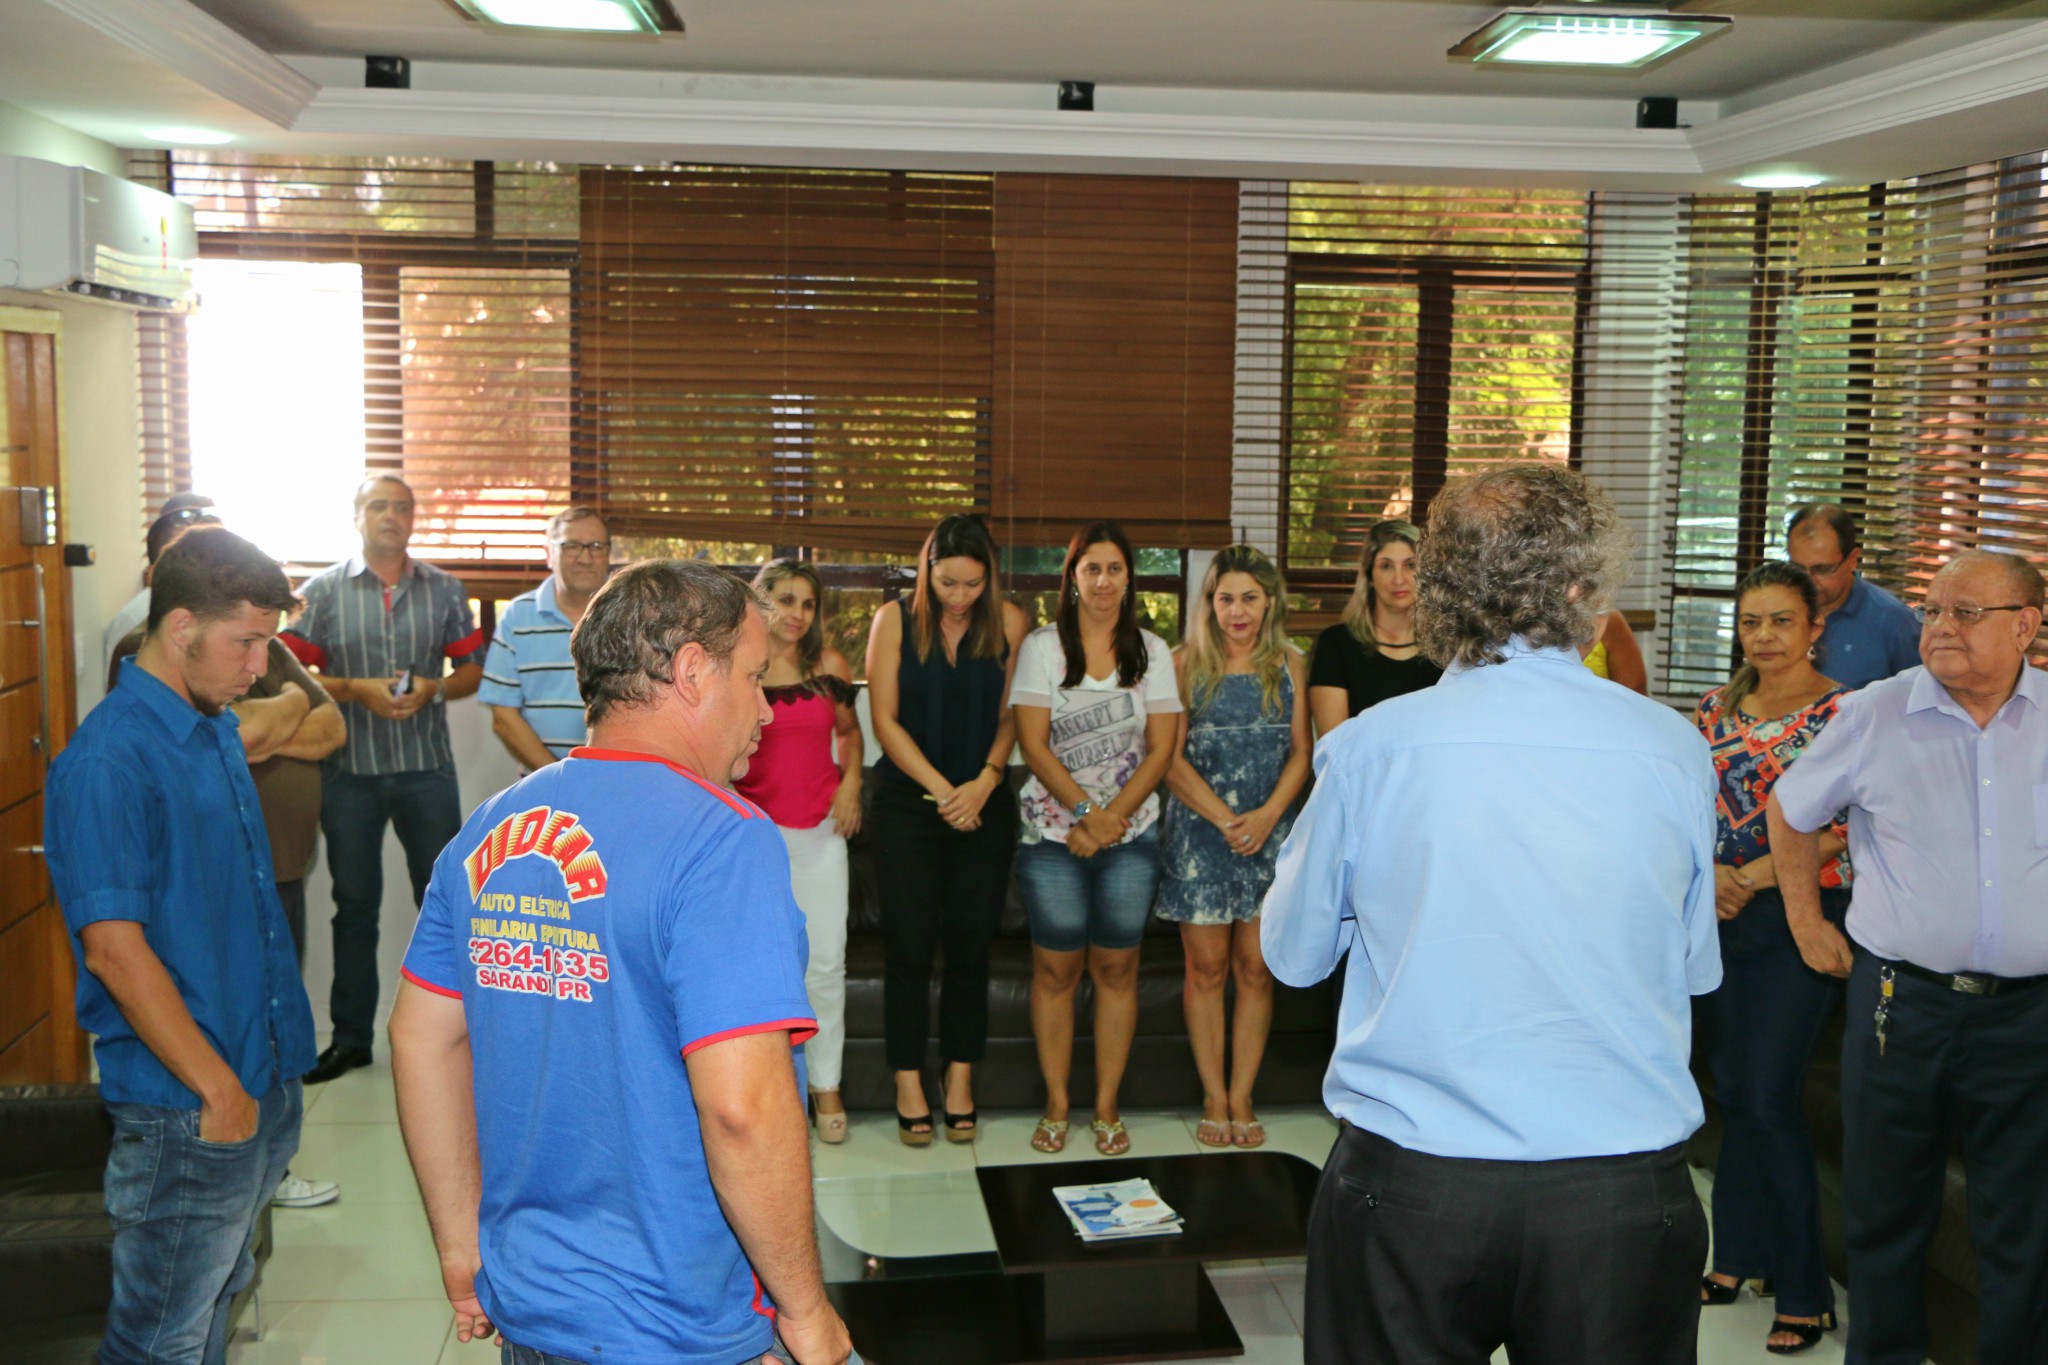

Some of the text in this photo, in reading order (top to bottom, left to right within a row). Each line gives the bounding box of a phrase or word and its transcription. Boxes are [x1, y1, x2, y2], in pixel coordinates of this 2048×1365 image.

[480, 893, 516, 912] AUTO
[470, 918, 538, 941] FNILARIA
[477, 967, 592, 1002] SARANDI PR
